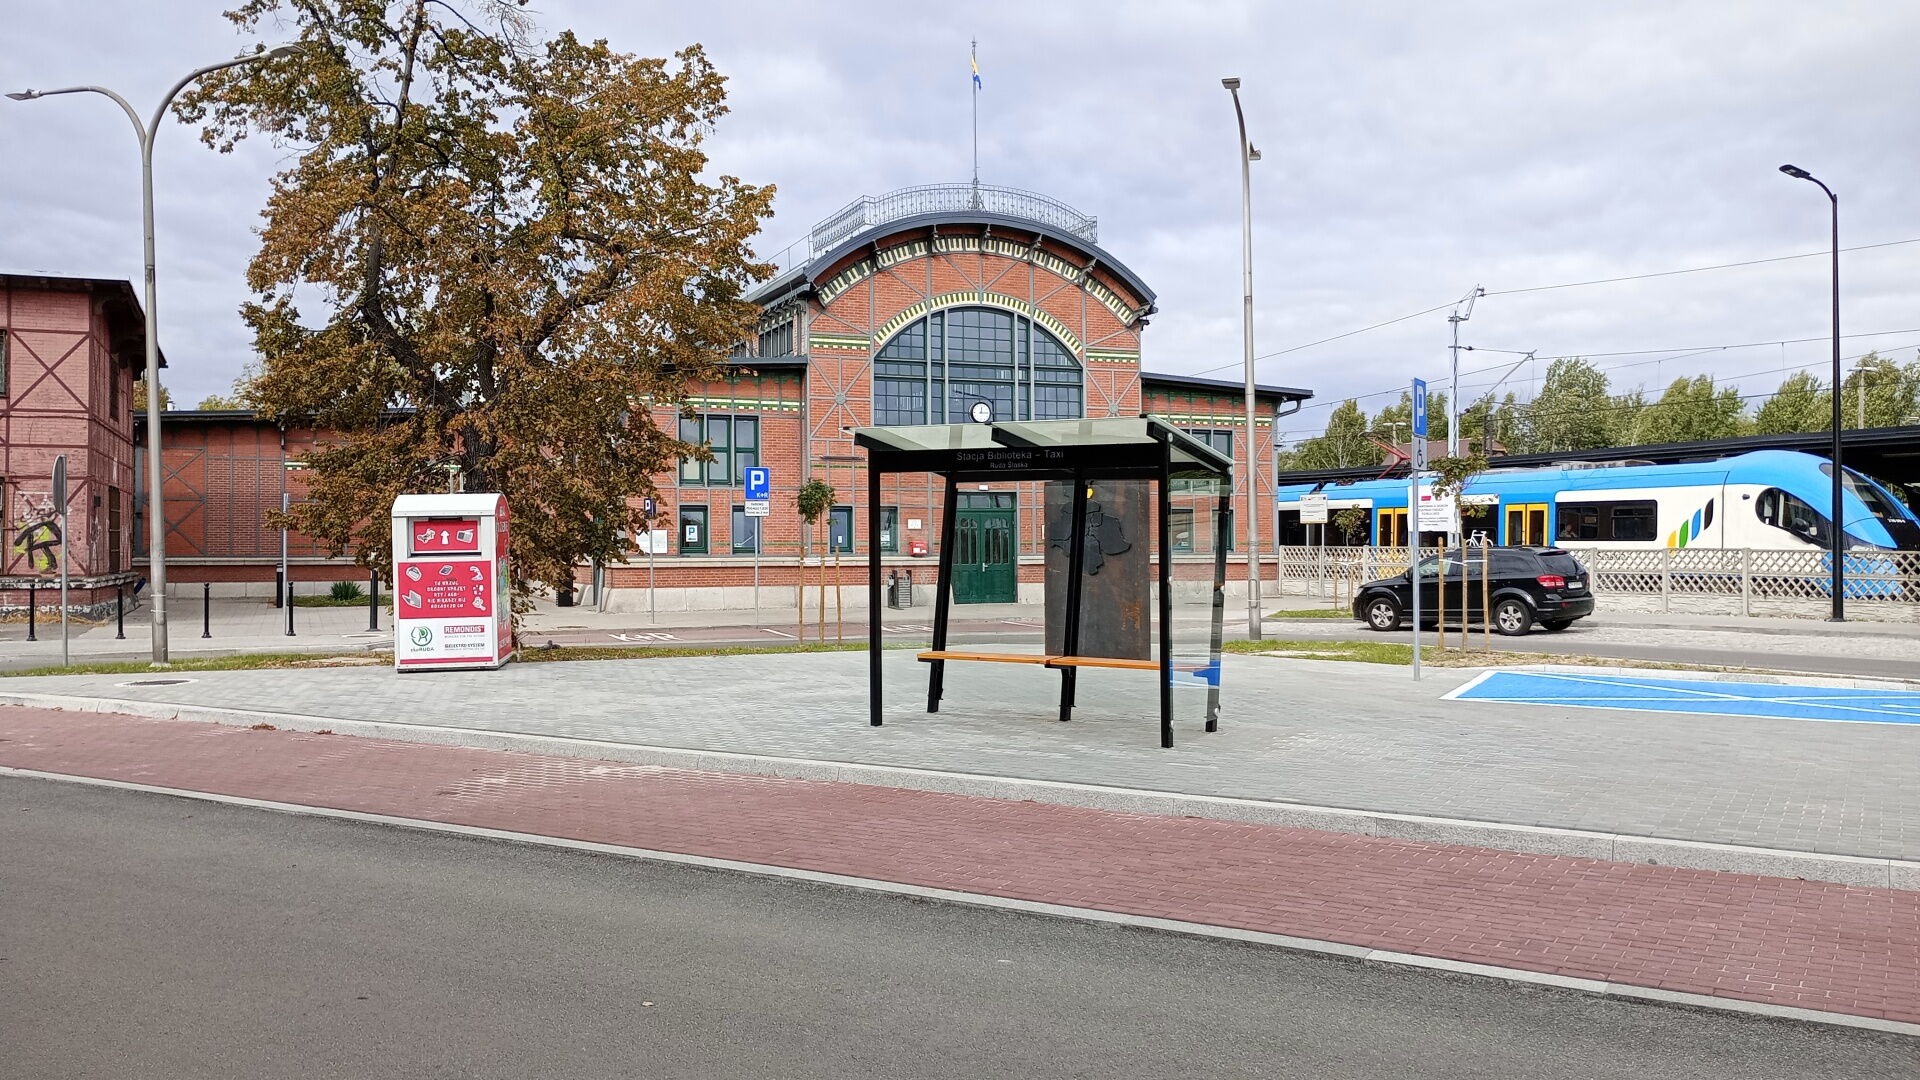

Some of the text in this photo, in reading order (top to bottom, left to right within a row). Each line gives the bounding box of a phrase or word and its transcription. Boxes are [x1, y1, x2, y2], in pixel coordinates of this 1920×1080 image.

[1416, 385, 1424, 428] P
[956, 452, 985, 462] Stacja
[987, 450, 1032, 460] Biblioteka
[1043, 449, 1064, 459] Taxi
[750, 470, 764, 491] P
[688, 527, 696, 536] P
